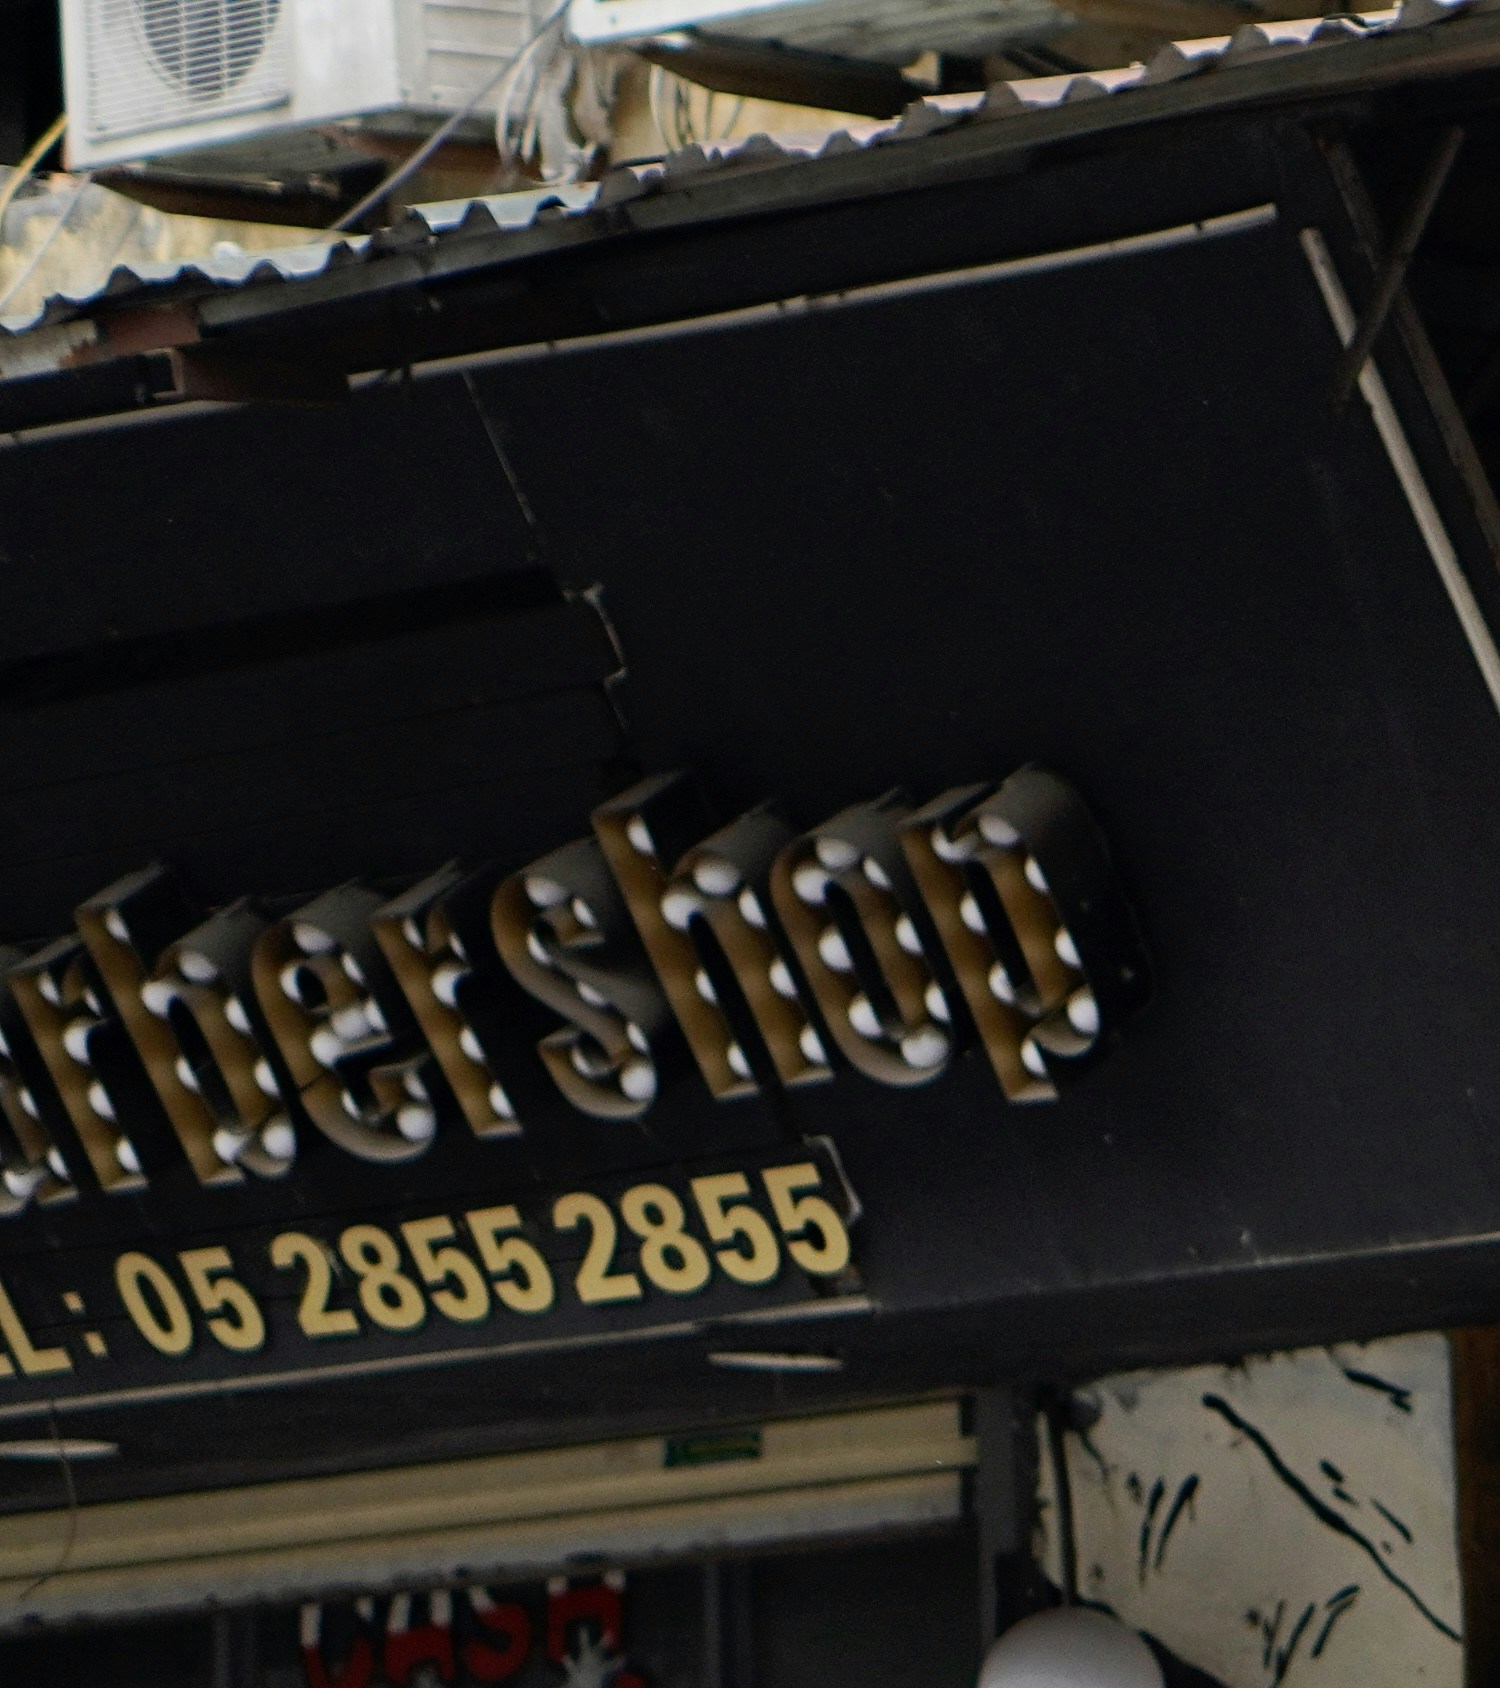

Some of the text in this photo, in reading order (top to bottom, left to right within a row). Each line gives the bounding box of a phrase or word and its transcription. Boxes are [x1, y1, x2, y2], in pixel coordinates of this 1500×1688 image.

[115, 1246, 266, 1357] 05
[272, 1204, 555, 1338] 2855
[551, 1161, 851, 1305] 2855
